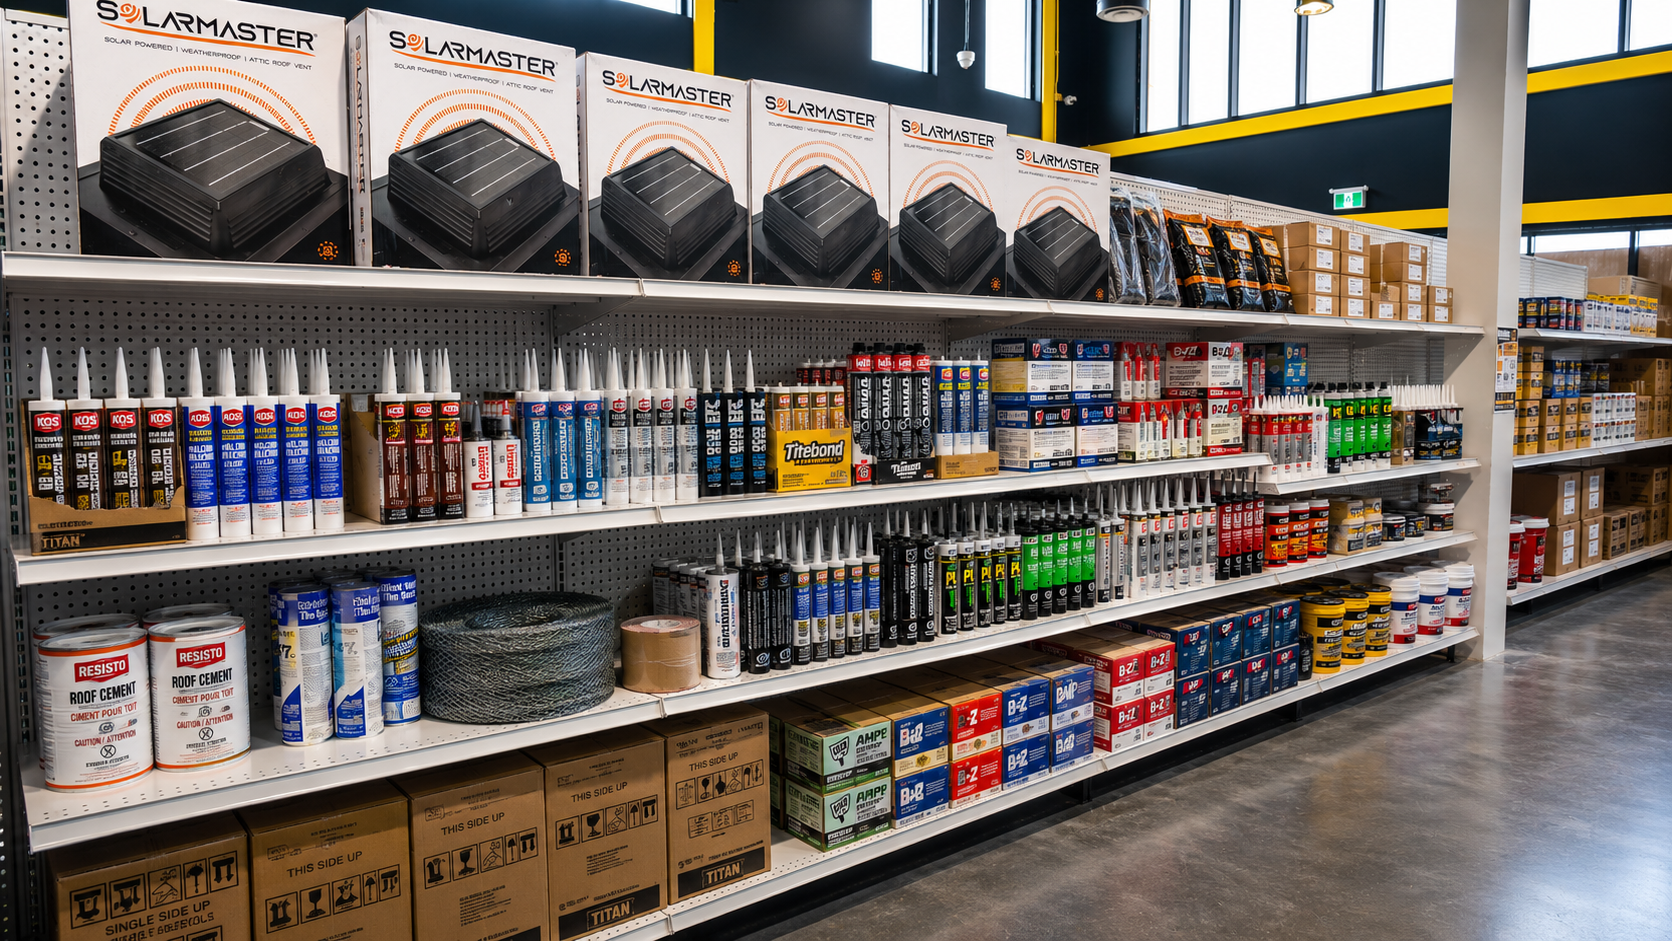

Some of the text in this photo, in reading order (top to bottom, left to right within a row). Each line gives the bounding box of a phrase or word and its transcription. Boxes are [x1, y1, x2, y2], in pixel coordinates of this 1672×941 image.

[96, 0, 315, 51] SOLARMASTER
[104, 36, 132, 46] SOLAR
[134, 40, 173, 52] POWERED
[182, 48, 242, 60] WEATHERPROOF
[249, 57, 270, 66] ATTIC
[389, 30, 555, 77] SOLARMASTER
[394, 62, 416, 71] SOLAR
[602, 70, 732, 108] SOLARMASTER
[765, 95, 875, 128] SOLARMASTER
[901, 118, 994, 148] SOLARMASTER
[1016, 148, 1099, 174] SOLARMASTER
[785, 440, 844, 462] Titebond
[41, 534, 80, 549] TITAN
[178, 647, 223, 663] RESISTO
[78, 662, 127, 678] RESISTO
[172, 668, 233, 688] ROOF CEMENT
[70, 680, 137, 705] ROOF CEMENT
[102, 706, 123, 718] POUR
[689, 752, 739, 772] THIS SIDE UP
[570, 782, 628, 803] THIS SIDE UP
[440, 812, 505, 836] THIS SIDE UP
[286, 850, 362, 878] THIS SIDE UP
[706, 862, 740, 885] TITAN
[105, 914, 155, 936] SINGLE
[158, 905, 189, 922] SIDE
[193, 900, 211, 913] UP
[590, 900, 631, 927] TITAN
